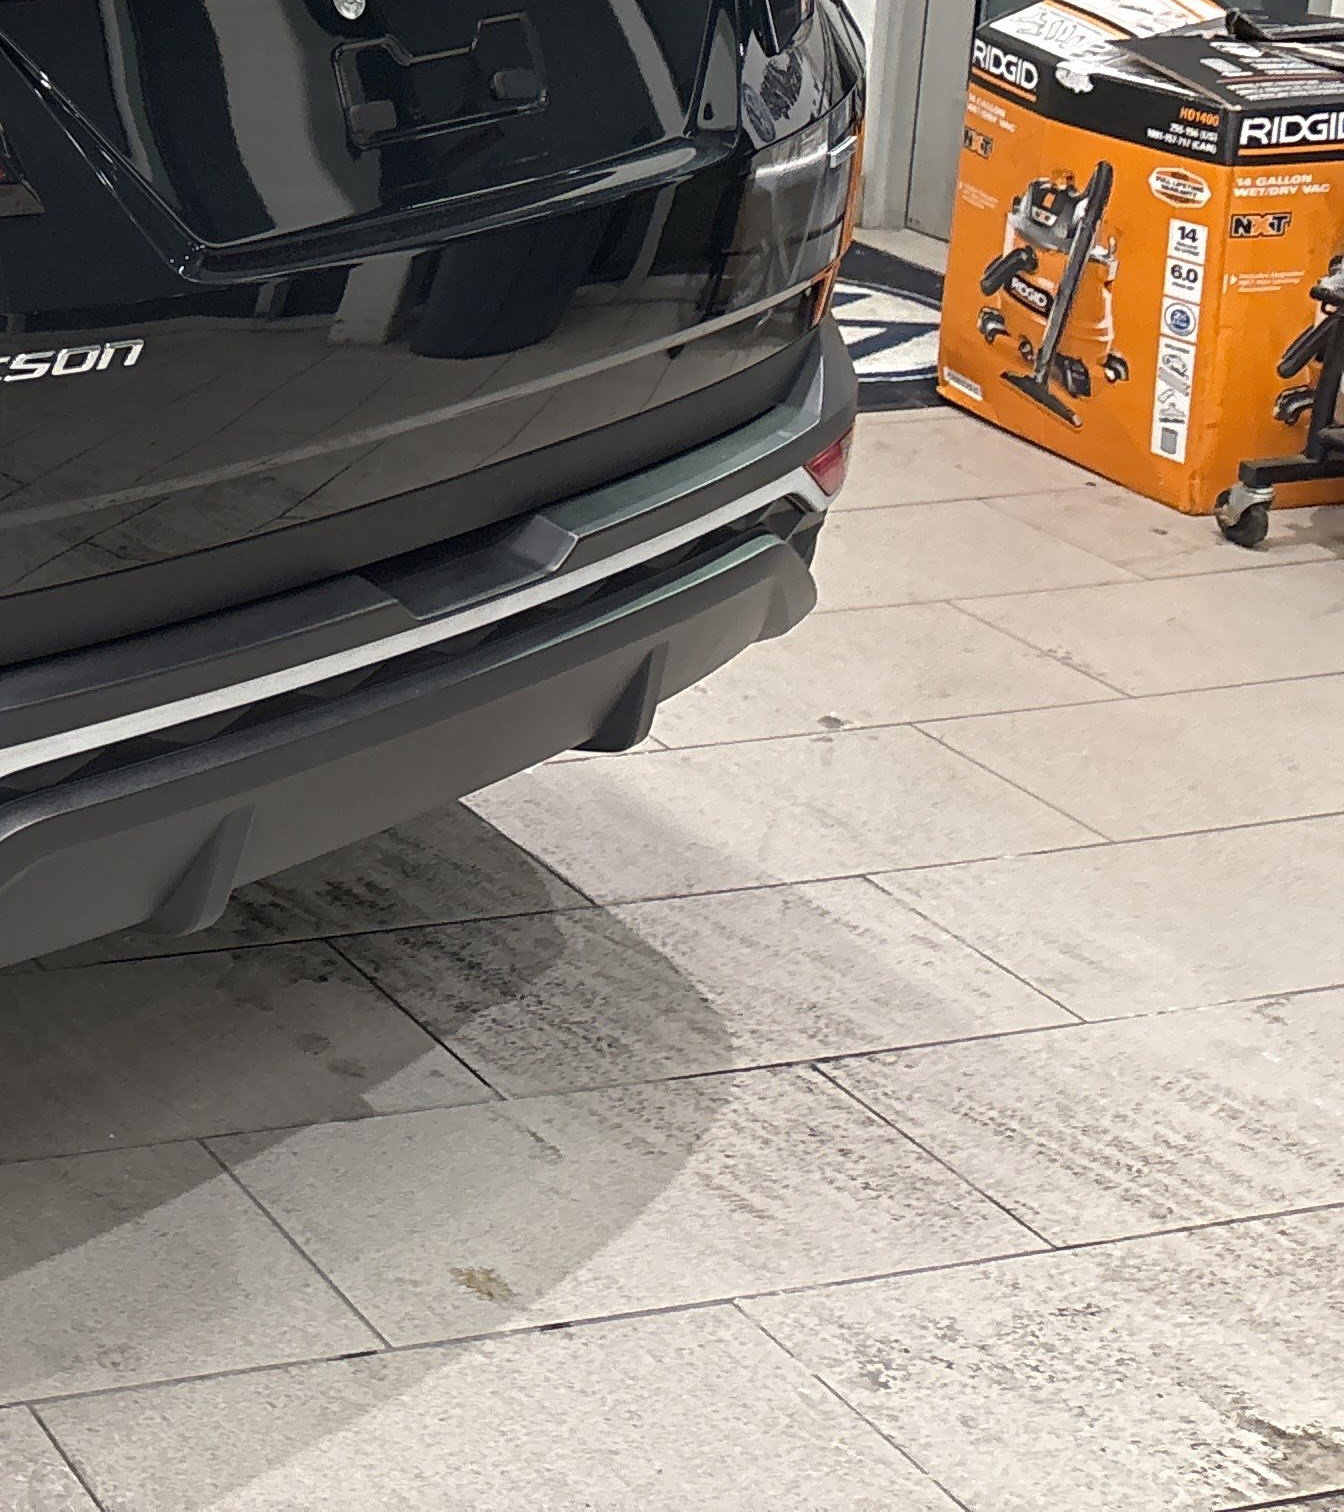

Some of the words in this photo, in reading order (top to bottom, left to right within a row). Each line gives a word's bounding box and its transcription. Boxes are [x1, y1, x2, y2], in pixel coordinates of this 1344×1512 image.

[971, 37, 1040, 91] RIDGID
[1177, 225, 1199, 243] 14
[1231, 212, 1292, 239] NXT
[1170, 263, 1198, 284] 6.0
